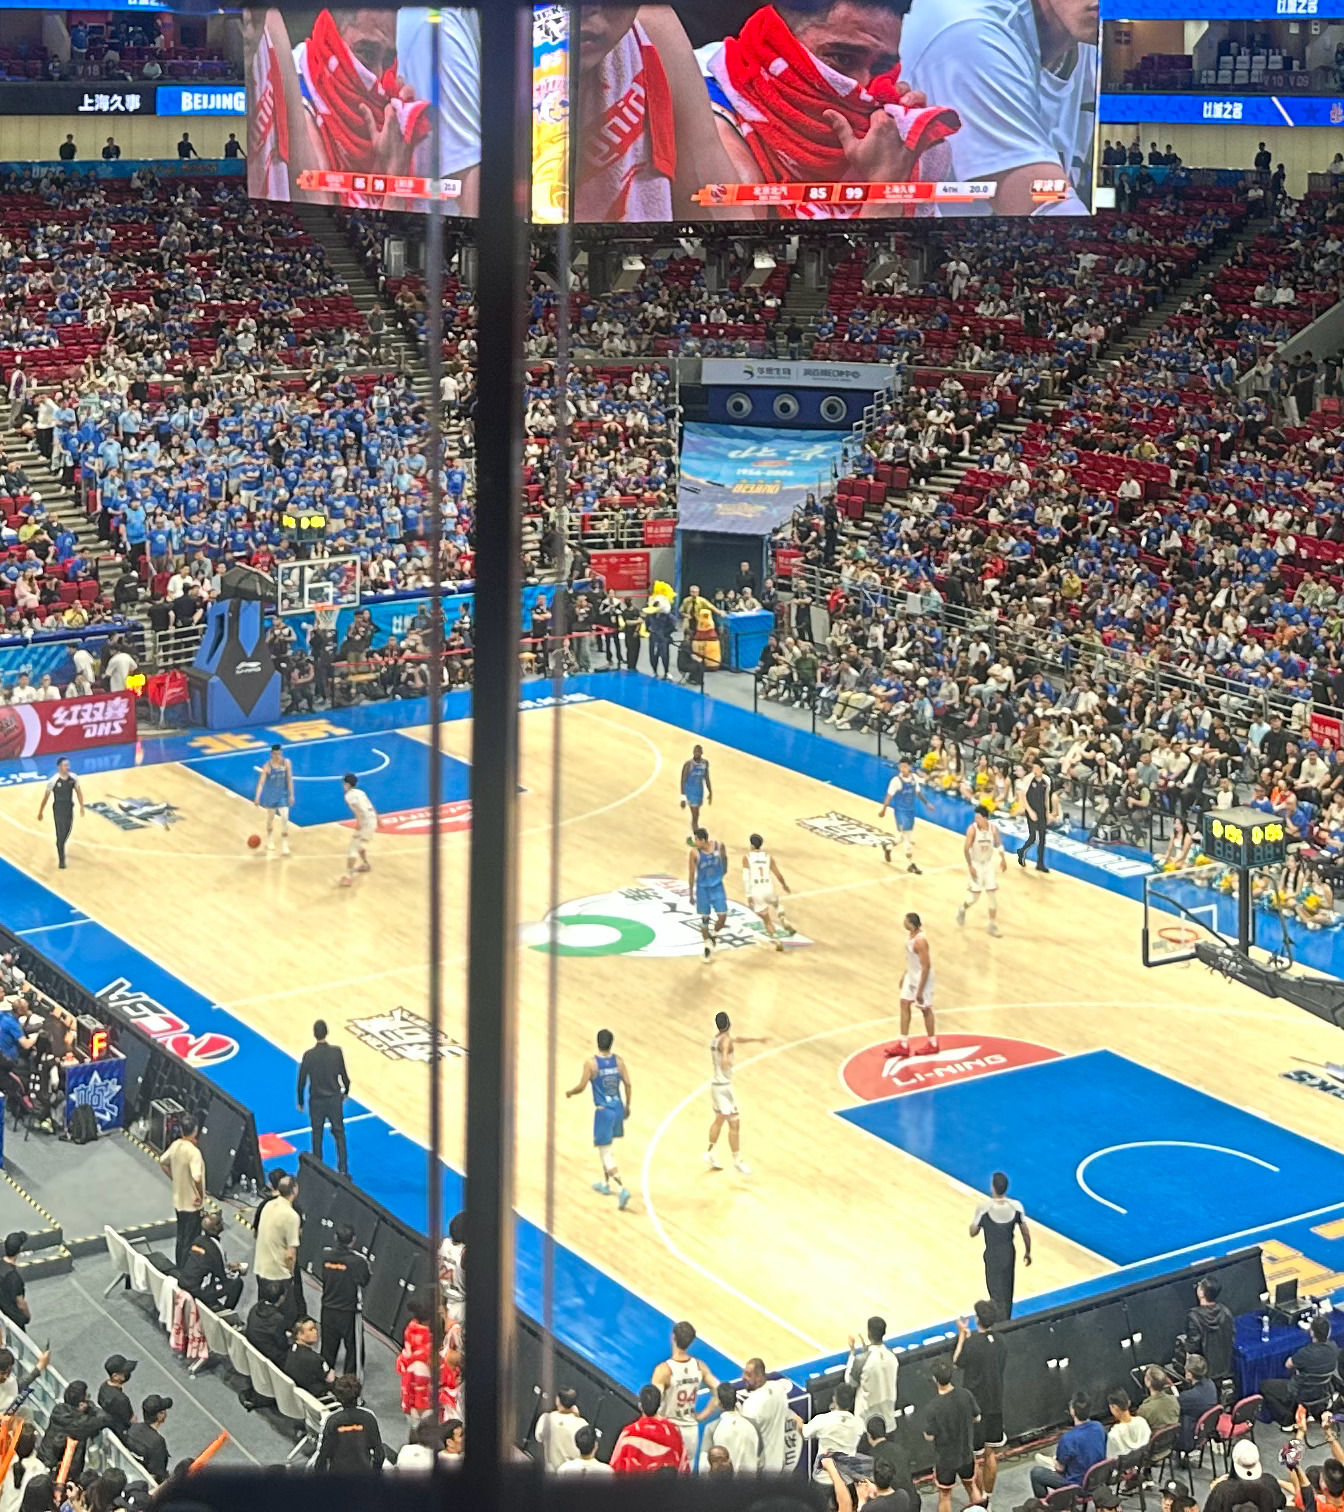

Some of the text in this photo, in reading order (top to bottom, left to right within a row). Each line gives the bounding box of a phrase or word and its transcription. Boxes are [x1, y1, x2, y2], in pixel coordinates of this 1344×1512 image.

[77, 93, 141, 112] 上海久事
[181, 91, 247, 111] BEIJING
[1203, 101, 1243, 119] 以城之名
[809, 187, 827, 199] 85
[845, 187, 863, 199] 99
[47, 695, 131, 736] 红双喜
[83, 718, 128, 739] DHS
[187, 719, 354, 755] 北京
[91, 1031, 108, 1060] F
[891, 1053, 1009, 1087] LI-NING
[676, 1388, 697, 1408] 94
